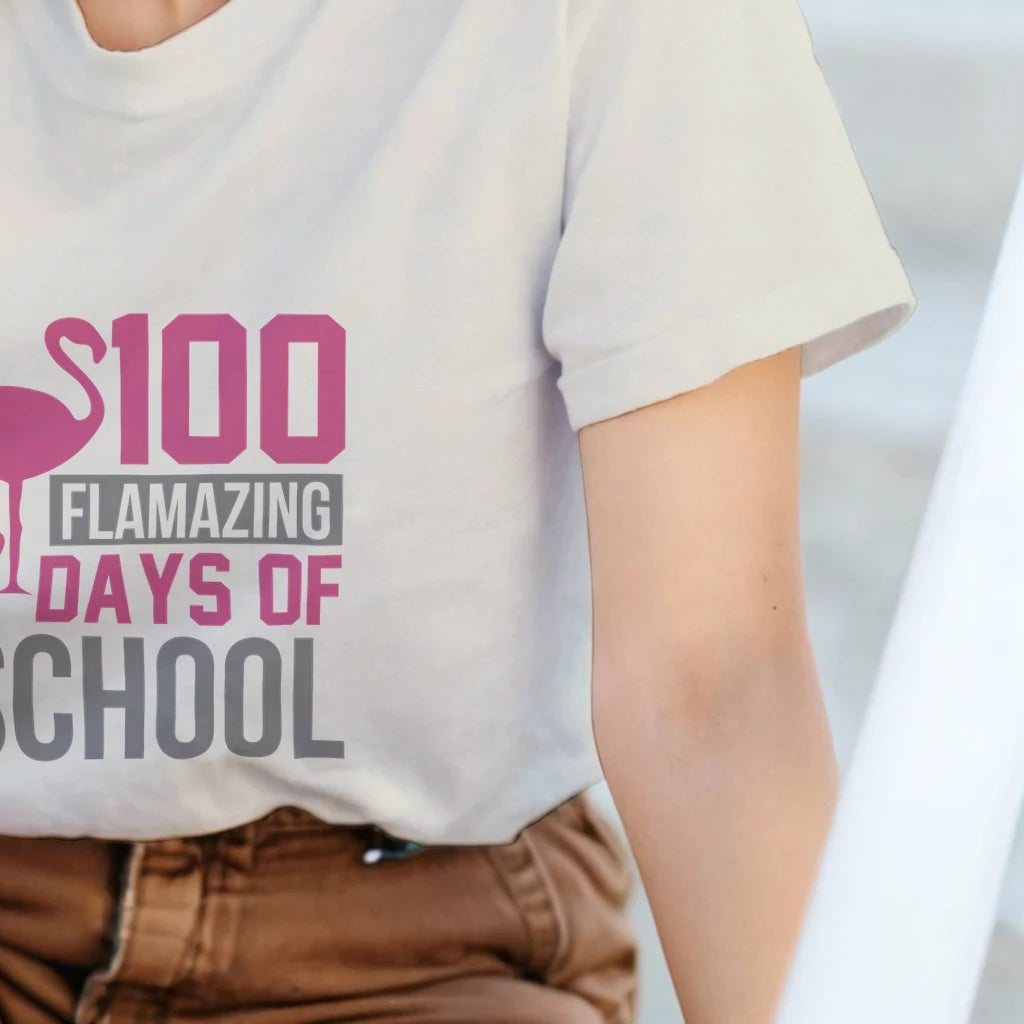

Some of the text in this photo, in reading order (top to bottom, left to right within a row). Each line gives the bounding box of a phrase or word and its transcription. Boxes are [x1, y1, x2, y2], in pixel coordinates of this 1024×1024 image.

[112, 313, 346, 465] 100
[61, 481, 330, 540] FLAMAZING
[35, 553, 342, 626] DAYS OF
